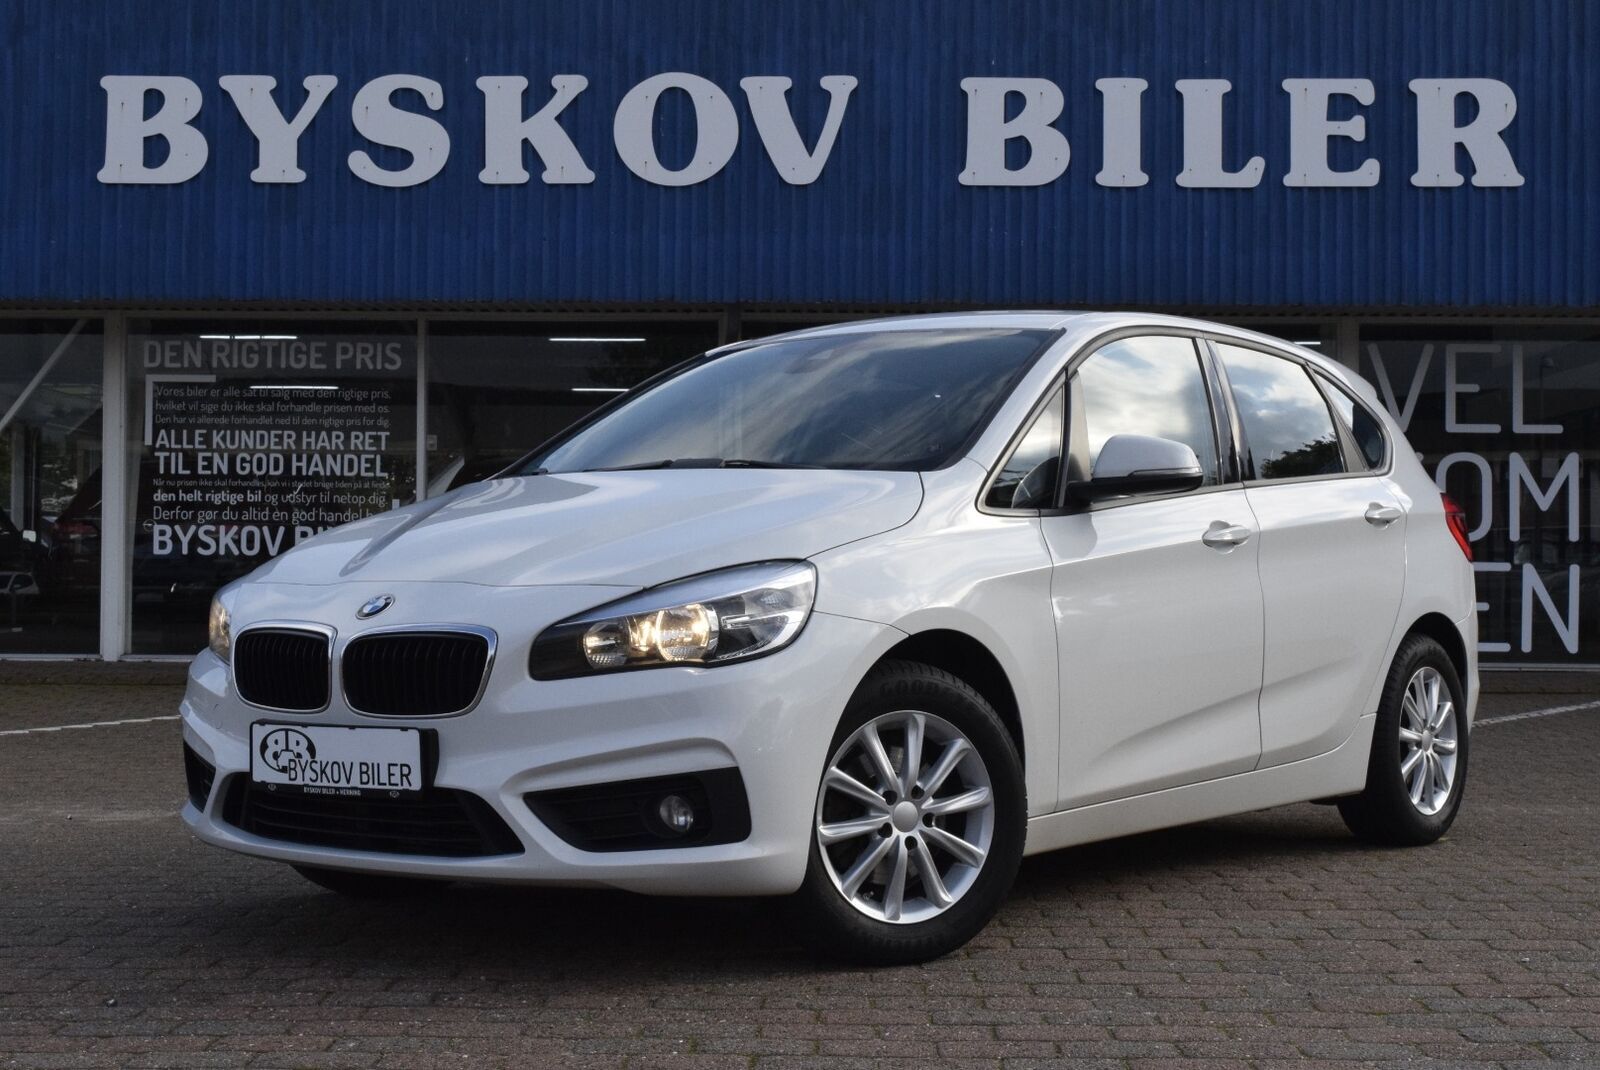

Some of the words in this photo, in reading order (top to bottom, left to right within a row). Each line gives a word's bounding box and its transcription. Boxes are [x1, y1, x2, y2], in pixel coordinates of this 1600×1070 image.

[97, 71, 859, 187] BYSKOV
[957, 77, 1525, 188] BILER
[143, 340, 201, 369] DEN
[211, 341, 328, 370] RIGTIGE
[336, 342, 402, 371] PRIS
[156, 386, 185, 397] Vores
[187, 386, 208, 397] biler
[210, 388, 220, 397] er
[223, 386, 240, 398] alle
[292, 387, 315, 399] med
[317, 387, 336, 399] den
[338, 388, 369, 402] rigtige
[1367, 343, 1564, 434] VEL
[155, 400, 186, 412] hvilket
[188, 400, 198, 412] vil
[200, 401, 219, 414] sige
[221, 401, 233, 412] du
[235, 401, 254, 412] ikke
[257, 401, 275, 413] skal
[276, 401, 322, 413] forhandle
[323, 402, 353, 415] prisen
[354, 402, 376, 414] med
[155, 414, 172, 425] Den
[173, 414, 187, 425] har
[188, 415, 196, 425] vi
[196, 415, 230, 425] allerede
[231, 415, 273, 426] forhandlet
[274, 416, 290, 426] ned
[292, 416, 300, 426] til
[302, 416, 317, 426] den
[319, 416, 344, 429] rigtige
[346, 417, 361, 428] pris
[363, 416, 375, 426] for
[155, 429, 207, 449] ALLE
[212, 430, 296, 450] KUNDER
[302, 431, 345, 451] HAR
[350, 431, 390, 451] RET
[154, 452, 191, 475] TIL
[197, 452, 228, 475] EN
[236, 453, 284, 476] GOD
[291, 453, 388, 478] HANDEL
[153, 488, 176, 502] den
[178, 489, 203, 502] helt
[205, 489, 245, 505] rigtige
[247, 489, 262, 502] bil
[264, 493, 279, 506] og
[281, 491, 318, 506] udstyr
[319, 491, 330, 504] til
[333, 492, 365, 508] netop
[1414, 451, 1580, 542] OM
[153, 505, 195, 520] Derfor
[198, 510, 219, 524] gør
[222, 506, 239, 520] du
[241, 506, 269, 521] altid
[291, 507, 316, 525] god
[319, 507, 362, 523] handel
[152, 524, 285, 557] BYSKOV
[287, 758, 354, 785] BYSKOV
[359, 762, 412, 787] BILER
